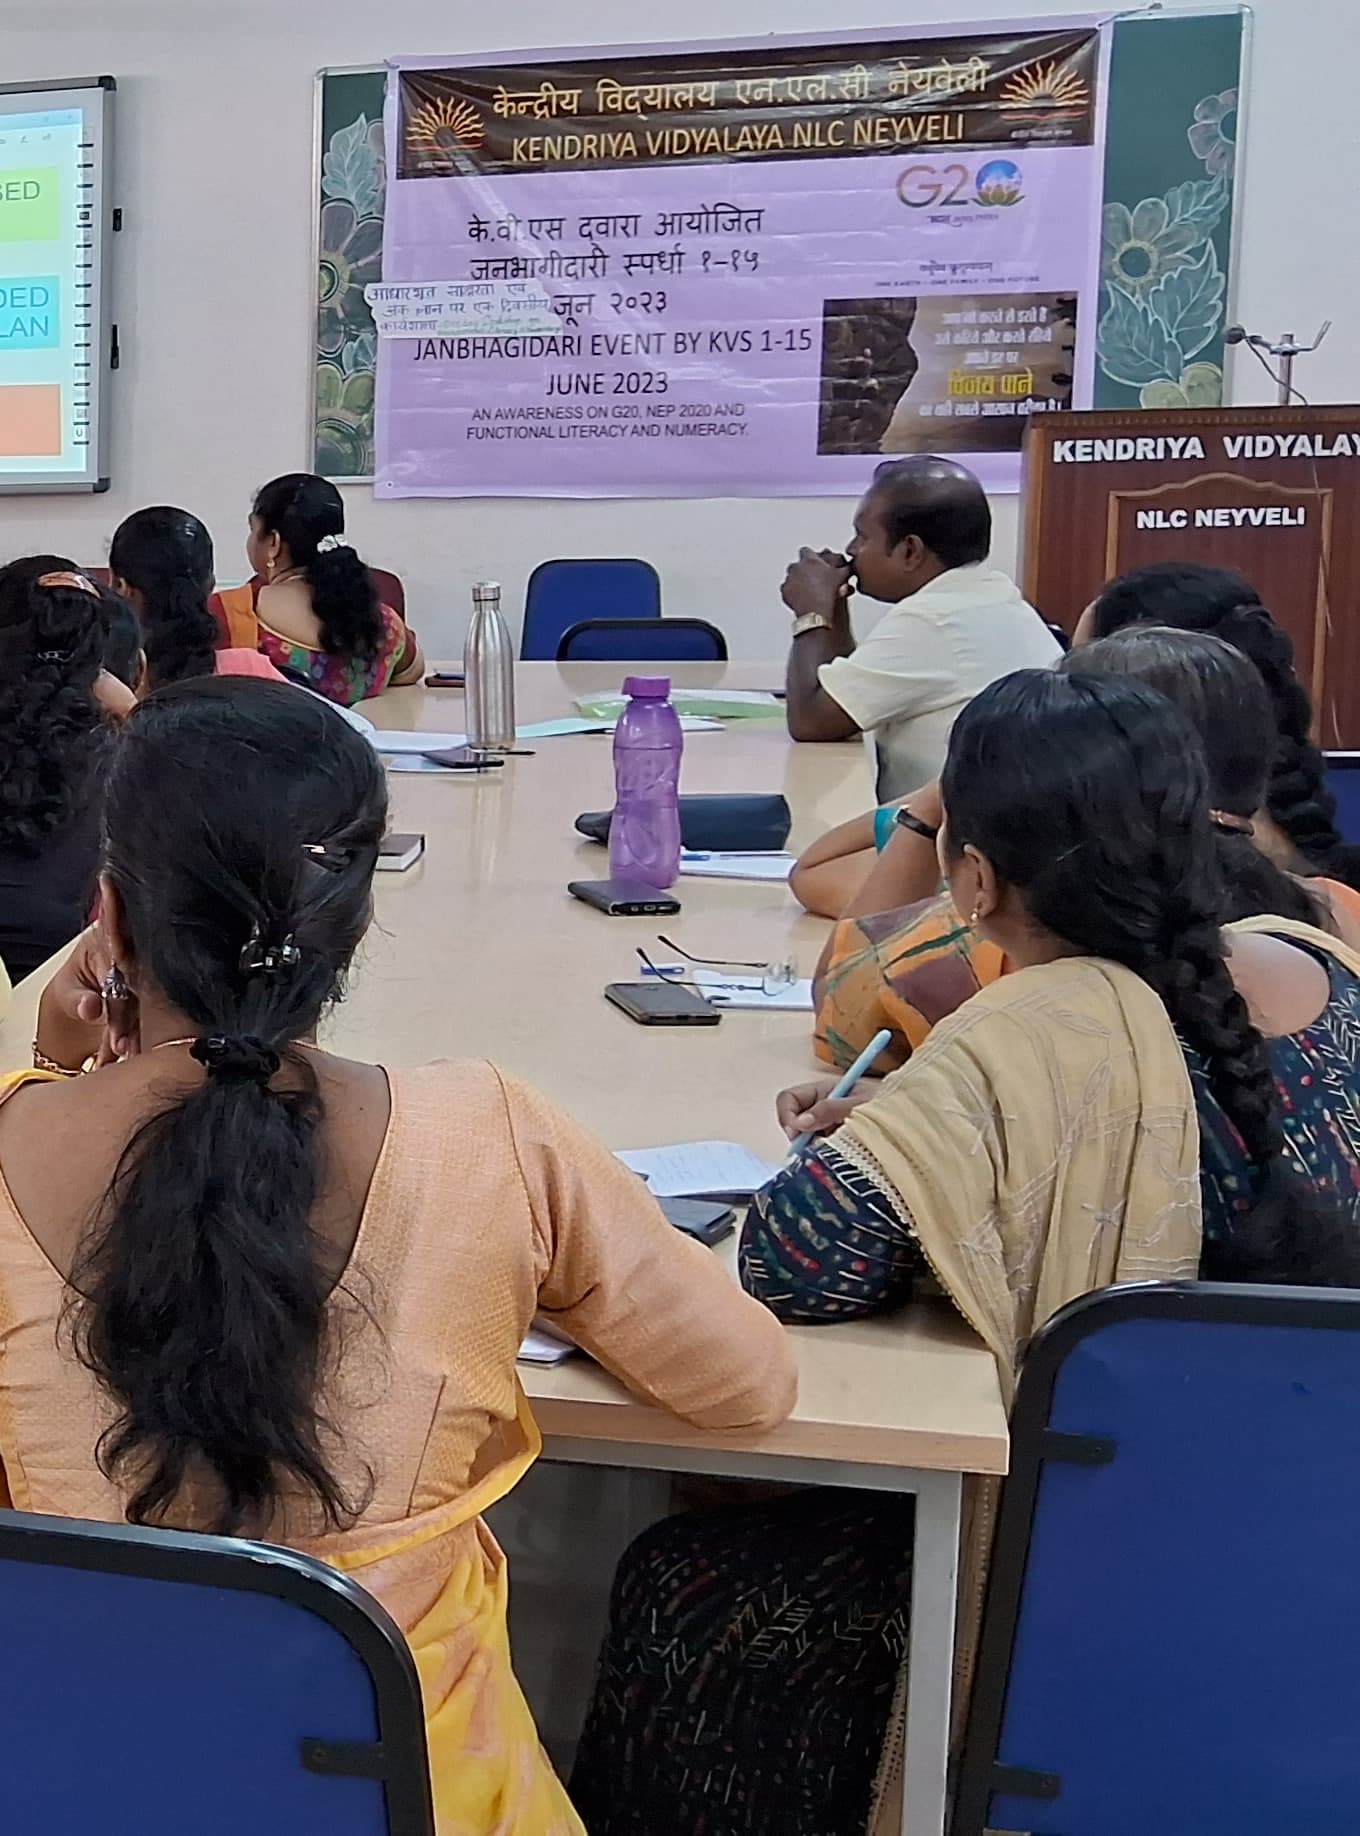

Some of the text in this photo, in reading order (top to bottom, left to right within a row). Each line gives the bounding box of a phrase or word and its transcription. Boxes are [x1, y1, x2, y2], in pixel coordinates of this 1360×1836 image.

[493, 82, 582, 119] केन्द्रीय
[596, 79, 720, 120] विद्यालय
[513, 114, 964, 162] KENDRIYA VIDYALAYA NLC NEYVELI
[654, 203, 765, 234] आयोजित
[470, 245, 610, 280] जनभागीदारी
[623, 243, 686, 275] स्पर्धा
[553, 291, 667, 327] जून २०२३
[413, 328, 813, 361] JANBHAGIDARI EVENT BY KVS 1-15
[547, 371, 668, 396] JUNE 2023
[472, 407, 492, 421] AN
[494, 406, 583, 420] AWARENESS
[587, 405, 608, 419] ON
[647, 404, 675, 418] NEP
[679, 403, 712, 417] 2020
[714, 402, 745, 416] AND
[467, 426, 556, 440] FUNCTIONAL
[559, 424, 629, 438] LITERACY
[631, 424, 660, 437] AND
[1053, 436, 1205, 463] KENDRIYA
[1137, 507, 1305, 529] NLC NEYVELI
